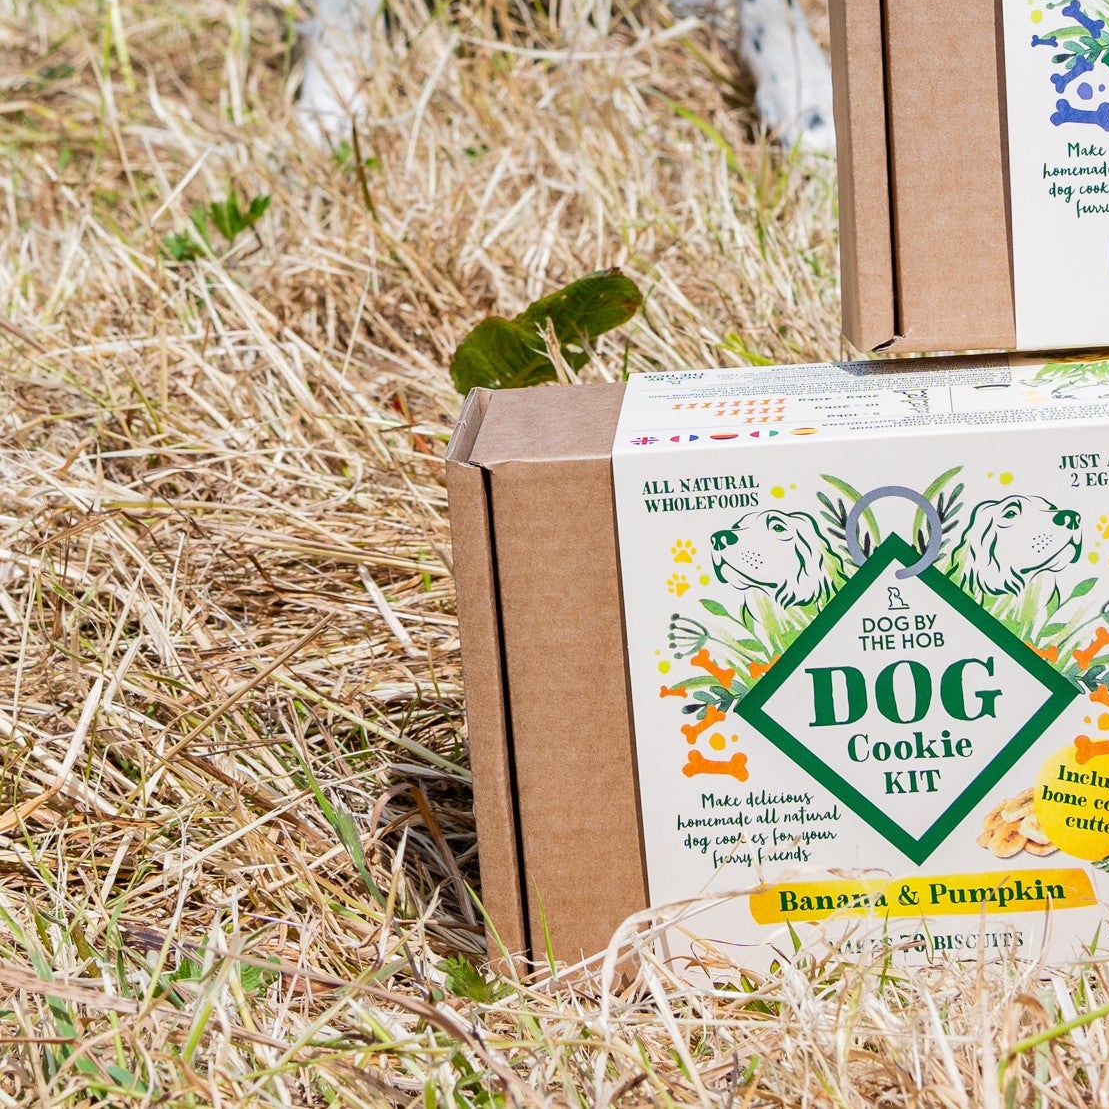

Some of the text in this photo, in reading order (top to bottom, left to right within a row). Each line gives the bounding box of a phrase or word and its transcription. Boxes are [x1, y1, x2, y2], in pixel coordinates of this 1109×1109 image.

[1067, 142, 1106, 157] Make
[1049, 182, 1075, 203] dog
[1058, 453, 1100, 470] JUST
[642, 475, 760, 495] ALL NATURAL
[1070, 472, 1080, 487] 2
[644, 493, 760, 513] WHOLEFOODS
[862, 615, 937, 633] DOG BY
[858, 633, 945, 651] THE HOB
[804, 657, 1002, 727] DOG
[847, 731, 972, 763] Cookie
[884, 769, 941, 795] KIT
[701, 789, 814, 809] Make delicious
[1041, 785, 1087, 809] bone
[677, 805, 842, 831] homemade all natural
[684, 827, 838, 854] dog cookes for your
[713, 850, 752, 869] furry
[779, 879, 1066, 912] Banana & Pumpkin
